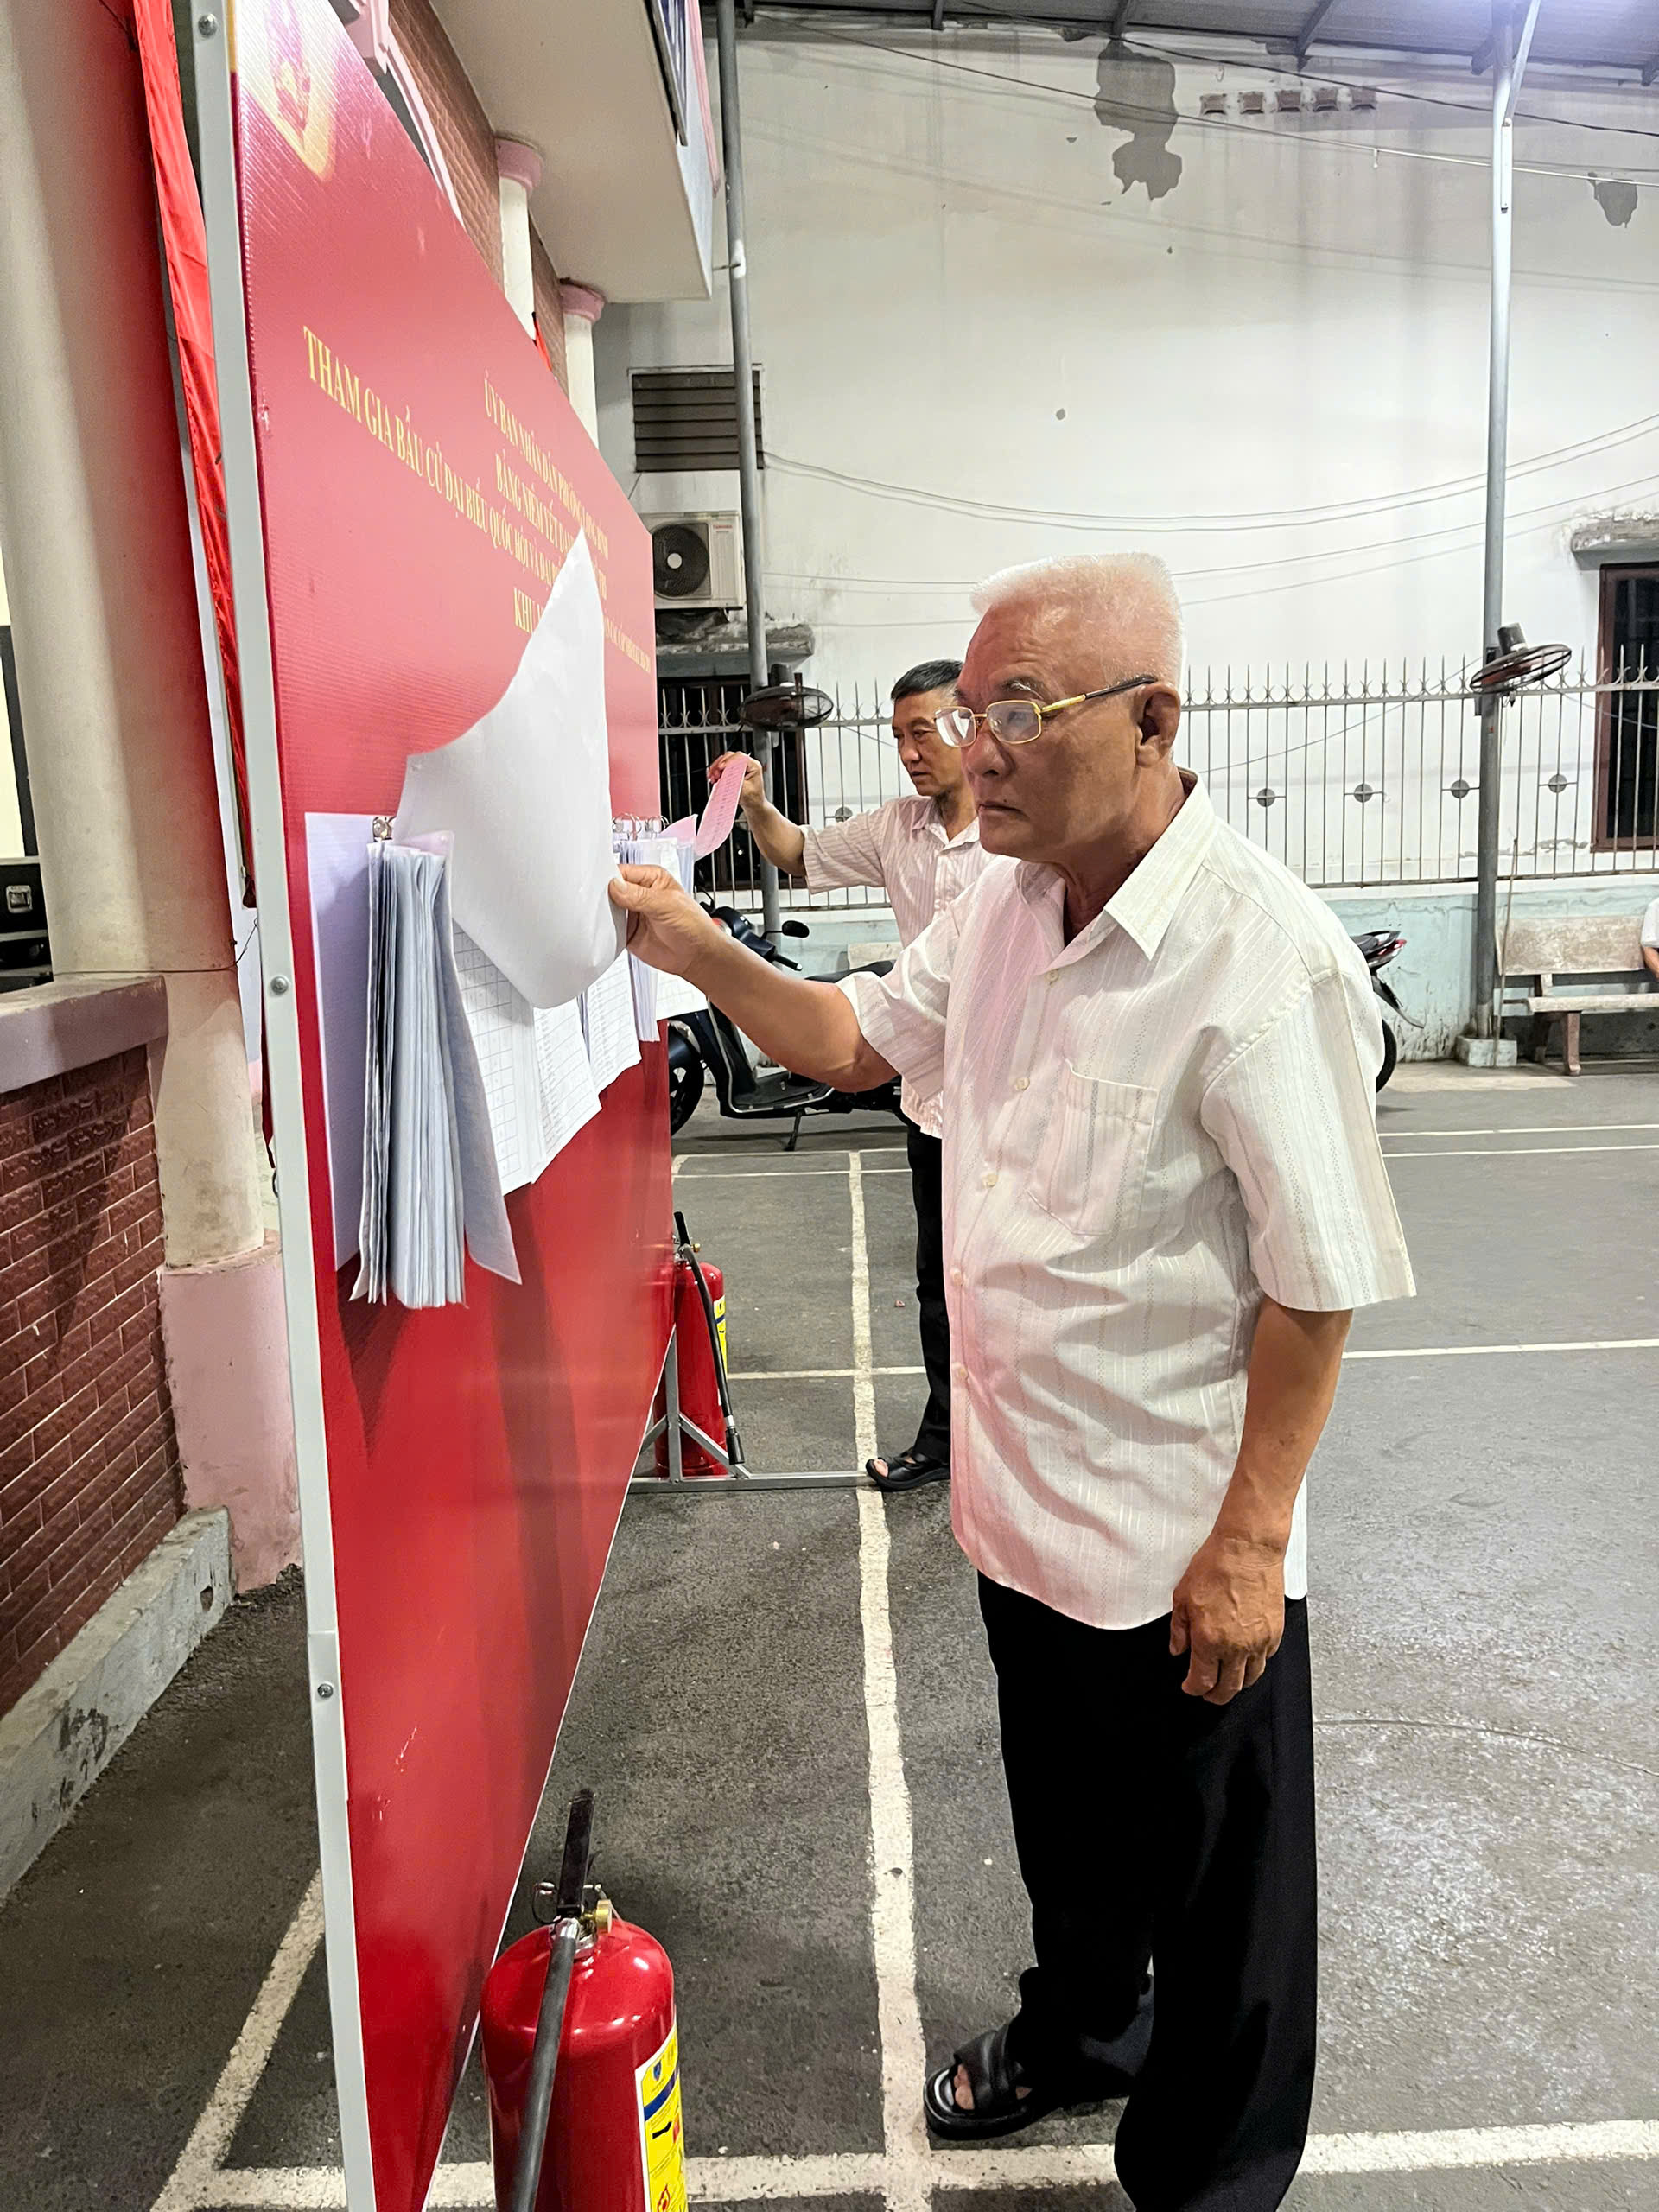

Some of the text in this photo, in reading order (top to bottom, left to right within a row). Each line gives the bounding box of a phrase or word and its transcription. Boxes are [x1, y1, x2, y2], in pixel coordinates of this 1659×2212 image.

[302, 324, 363, 423] THAM
[364, 387, 395, 453] GIA
[495, 448, 522, 512] BẢNG
